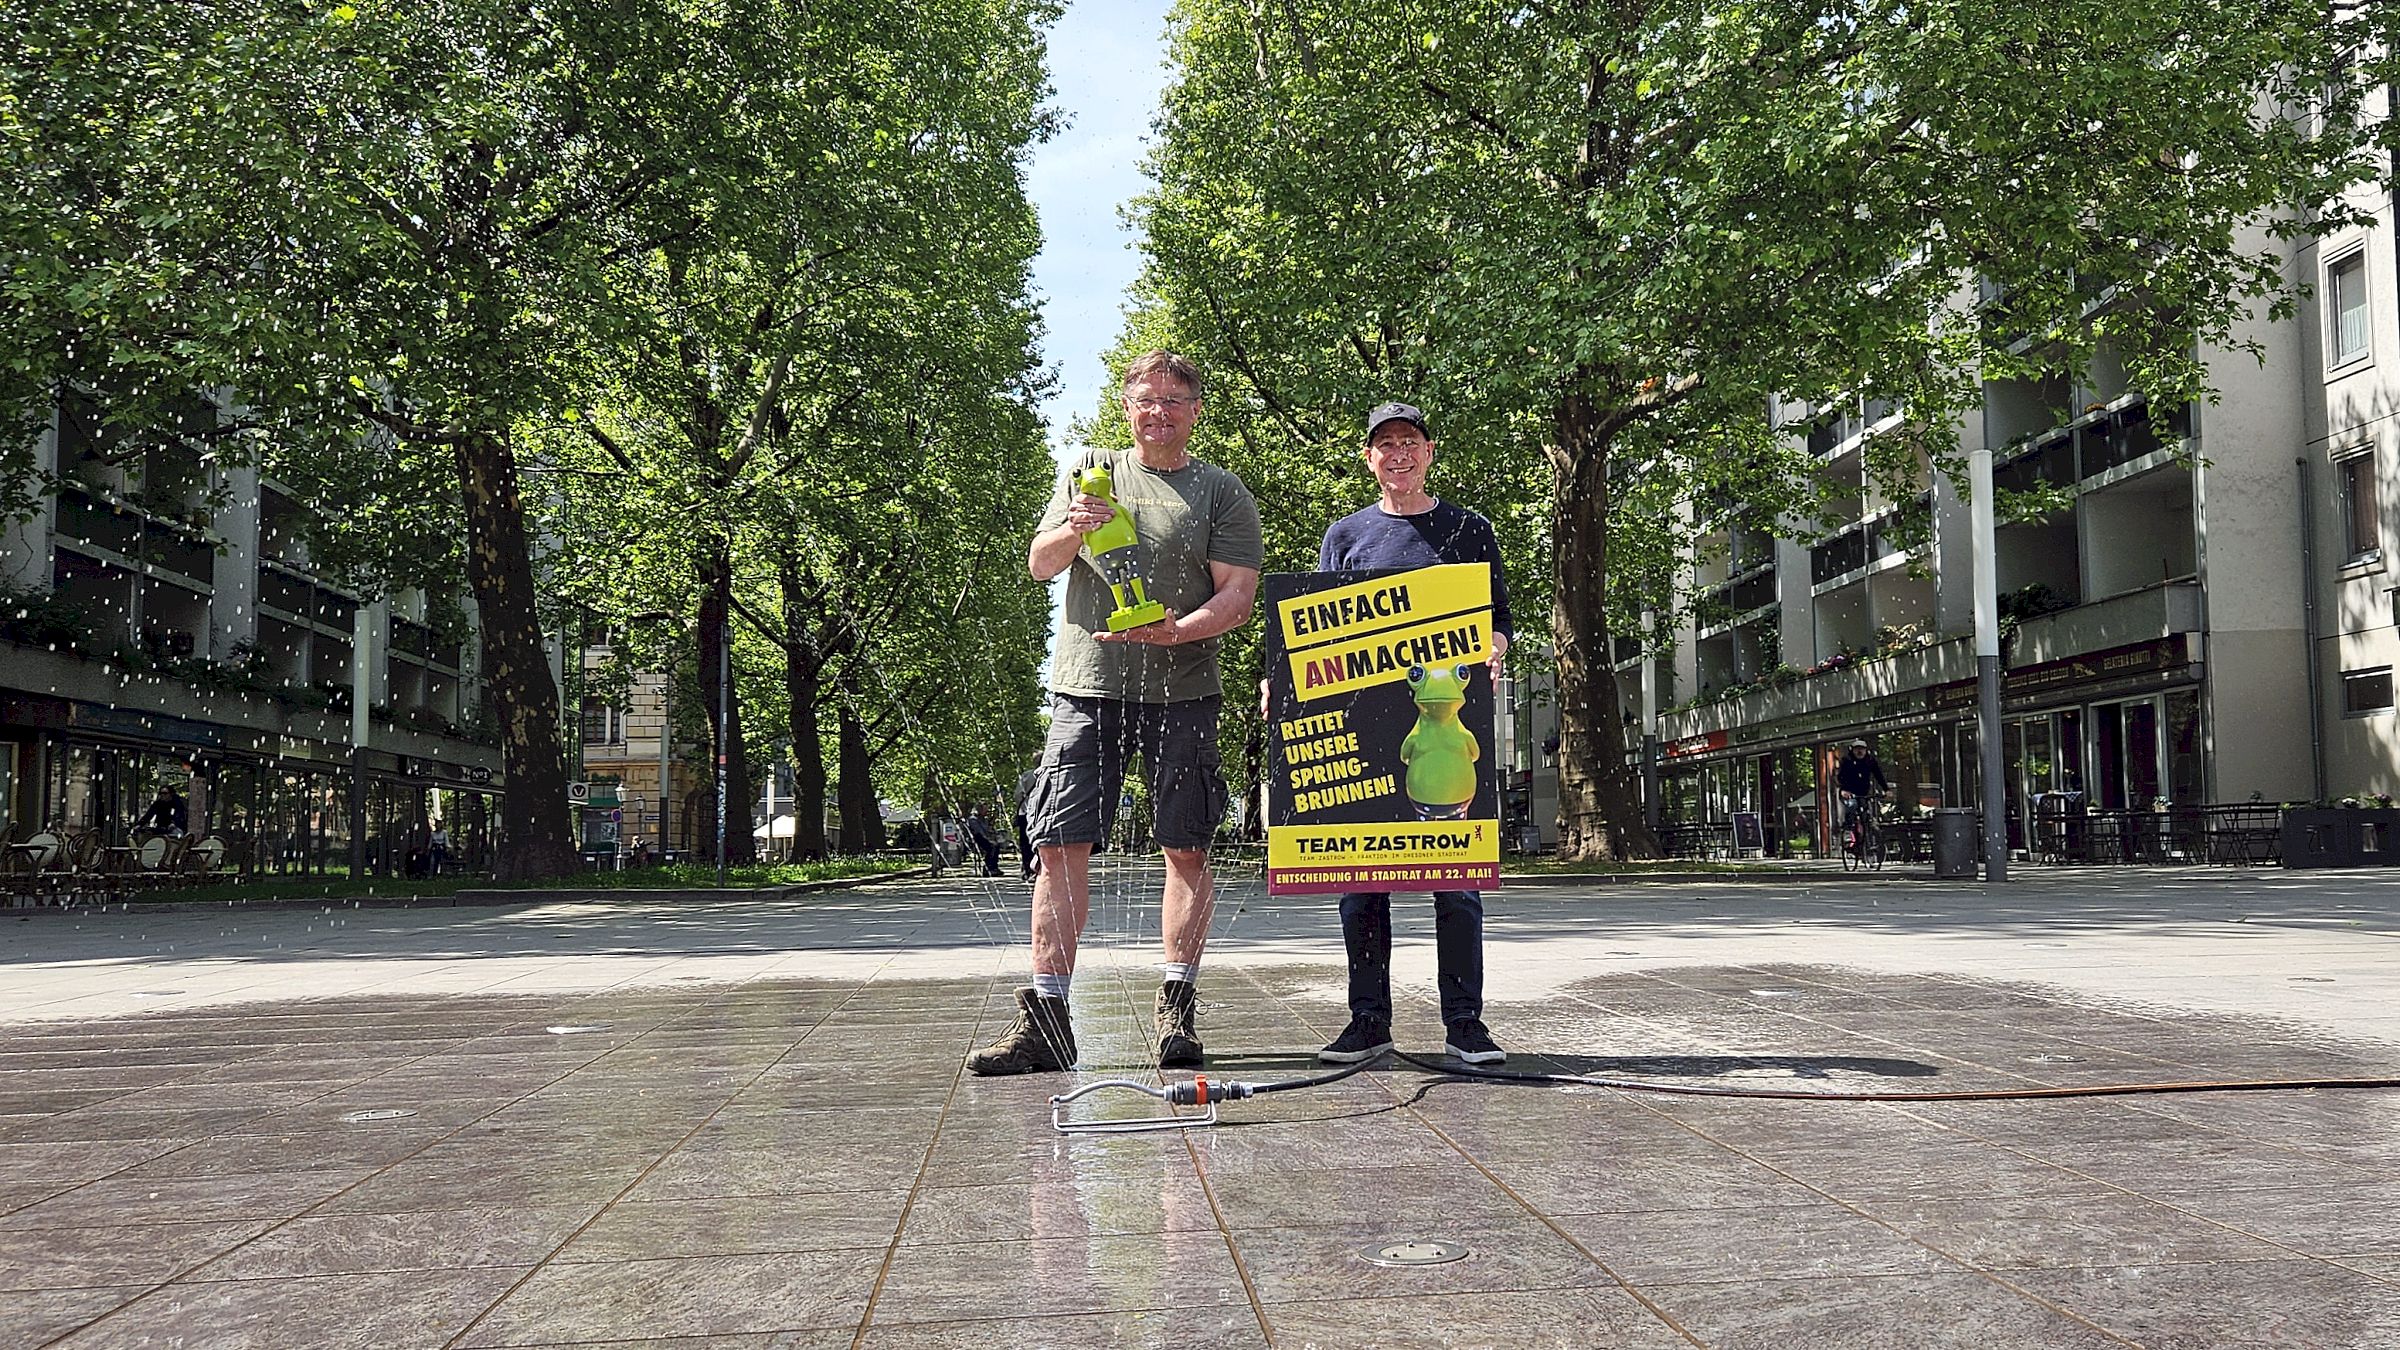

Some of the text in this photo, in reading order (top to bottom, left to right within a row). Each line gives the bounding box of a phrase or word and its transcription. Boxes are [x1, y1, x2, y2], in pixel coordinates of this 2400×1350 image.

[1291, 585, 1412, 637] EINFACH
[1304, 624, 1482, 689] ANMACHEN!
[1280, 710, 1345, 741] RETTET
[1285, 732, 1359, 765] UNSERE
[1290, 757, 1369, 789] SPRING-
[1295, 775, 1397, 813] BRUNNEN!
[1296, 833, 1471, 853] TEAM ZASTROW
[1276, 867, 1493, 884] ENTSCHEIDUNG IM STADTRAT AM 22. MAI!
